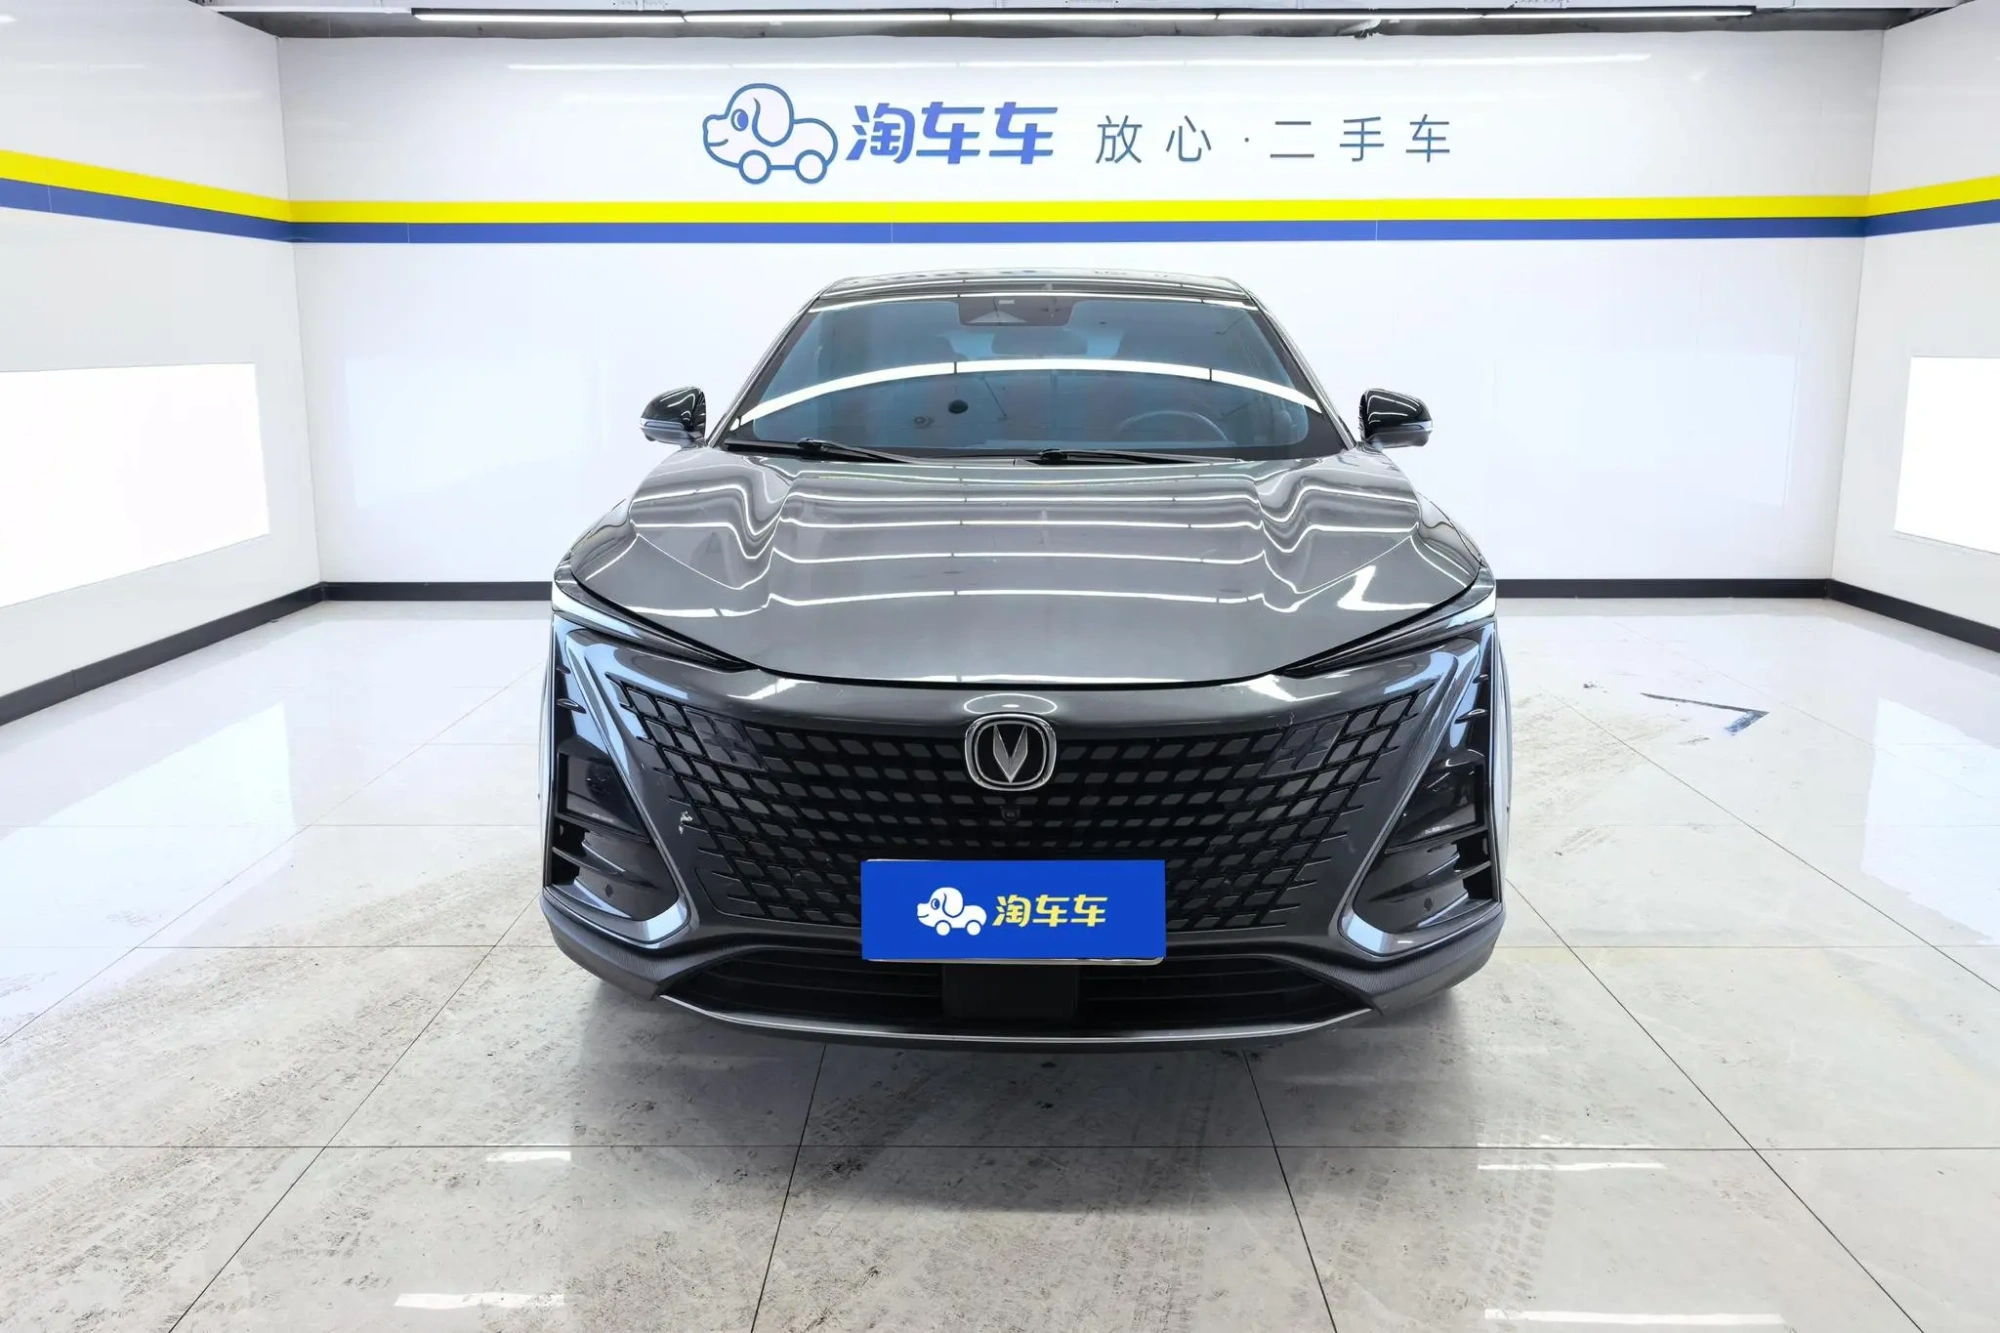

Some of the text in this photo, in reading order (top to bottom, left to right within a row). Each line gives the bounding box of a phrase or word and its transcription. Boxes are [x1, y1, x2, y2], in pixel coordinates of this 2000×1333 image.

[845, 101, 1059, 165] 淘车车
[992, 894, 1108, 928] 淘车车
